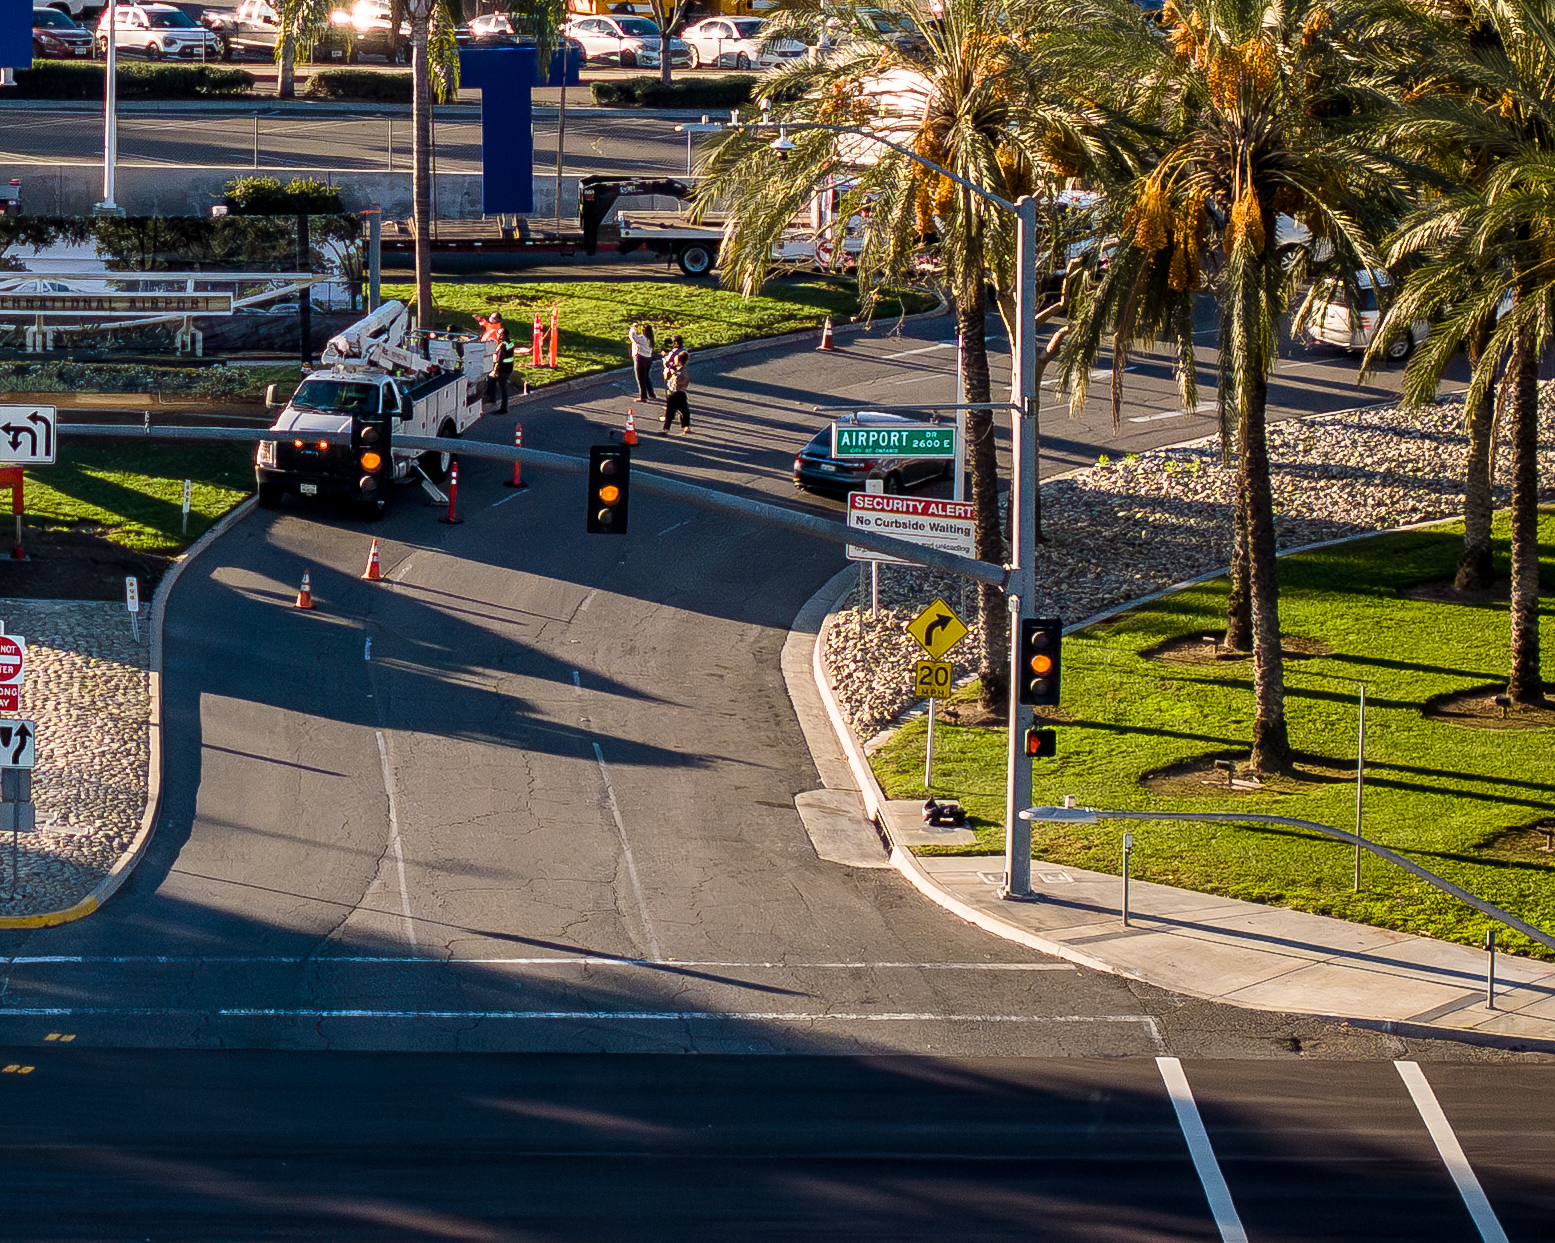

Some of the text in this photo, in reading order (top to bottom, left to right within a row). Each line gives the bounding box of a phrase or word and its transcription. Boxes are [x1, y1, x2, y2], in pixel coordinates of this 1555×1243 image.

[458, 46, 580, 214] T
[129, 298, 211, 311] AIRPORT
[841, 431, 909, 447] AIRPORT
[912, 440, 950, 448] 2600 E
[854, 495, 973, 518] SECURITY ALERT
[855, 515, 971, 537] No Curbside Waiting
[0, 644, 17, 654] NOT
[919, 666, 949, 686] 20
[922, 688, 944, 696] MPH
